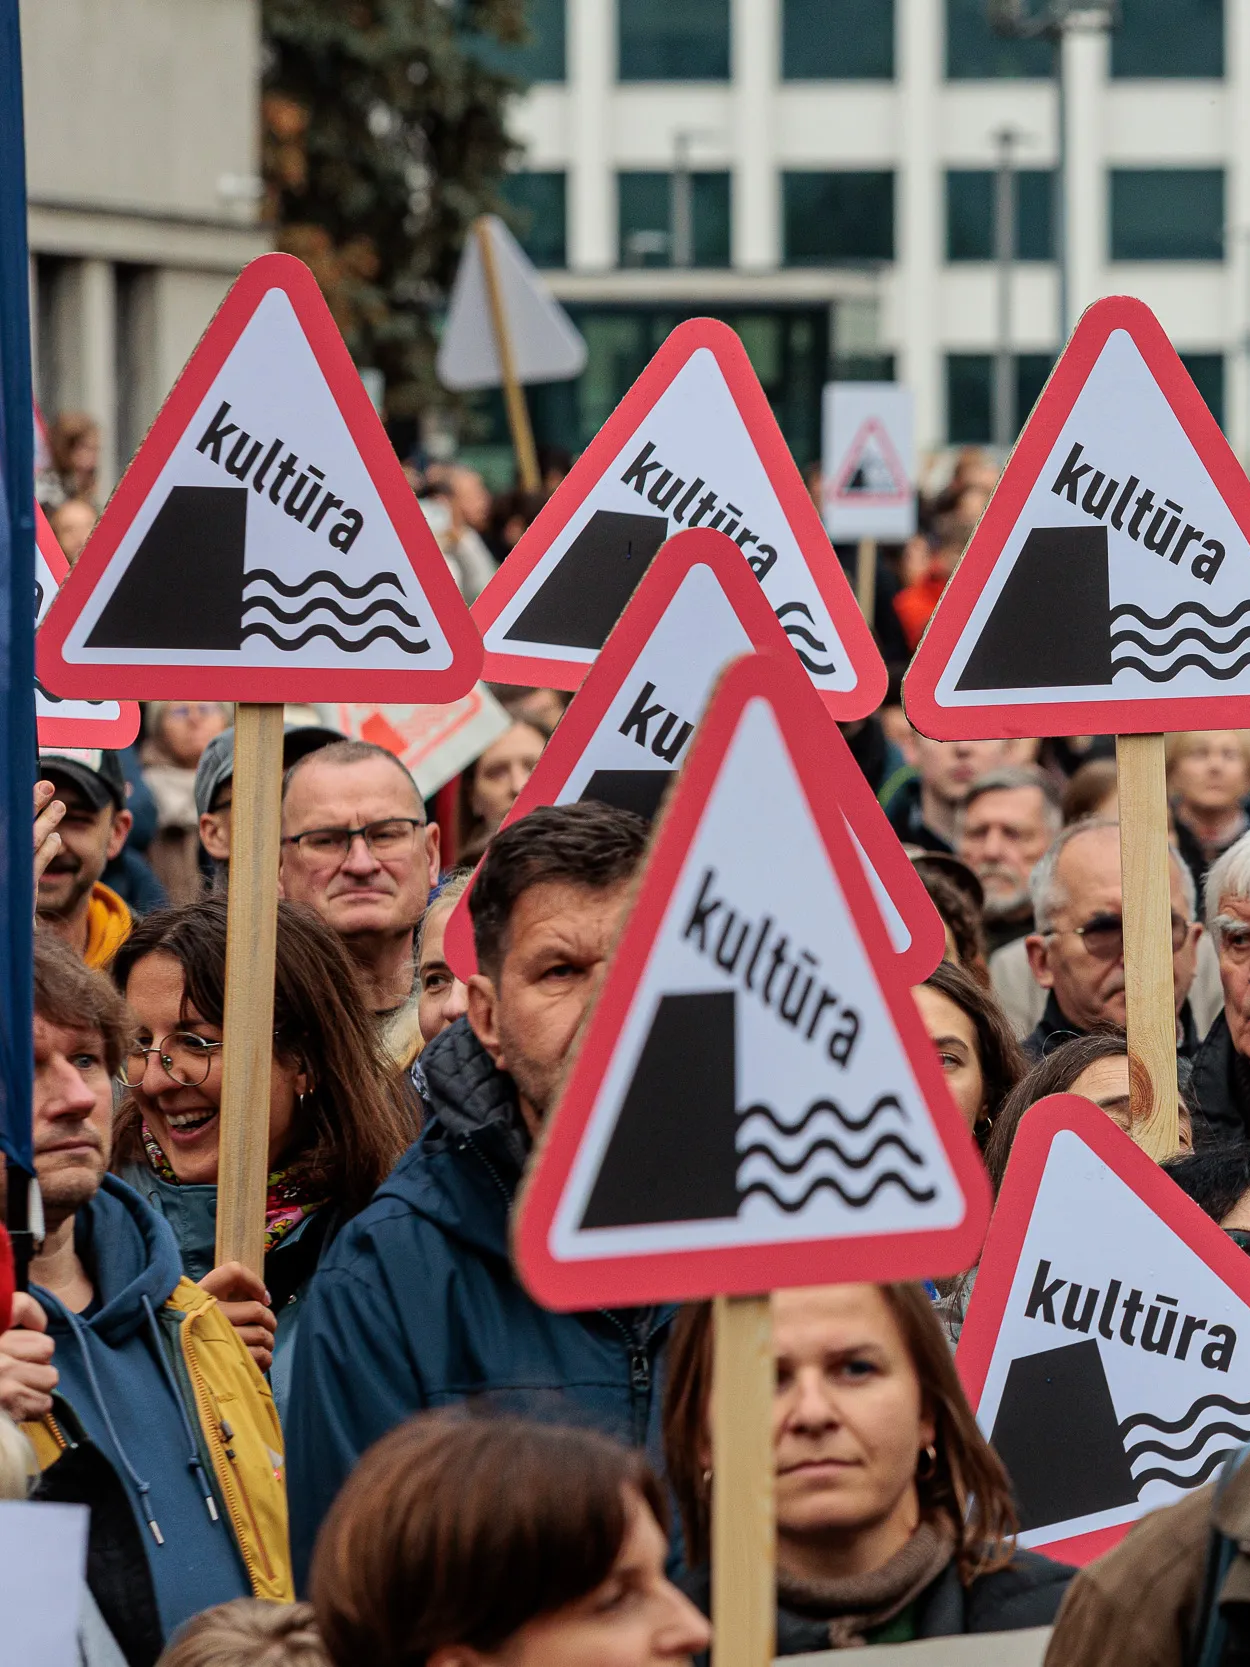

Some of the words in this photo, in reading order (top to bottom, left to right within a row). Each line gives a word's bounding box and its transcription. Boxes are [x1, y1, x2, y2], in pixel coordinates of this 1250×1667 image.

[195, 400, 364, 555] kultūra
[1050, 441, 1226, 586] kultūra
[683, 869, 861, 1069] kultūra
[1023, 1258, 1237, 1373] kultūra
